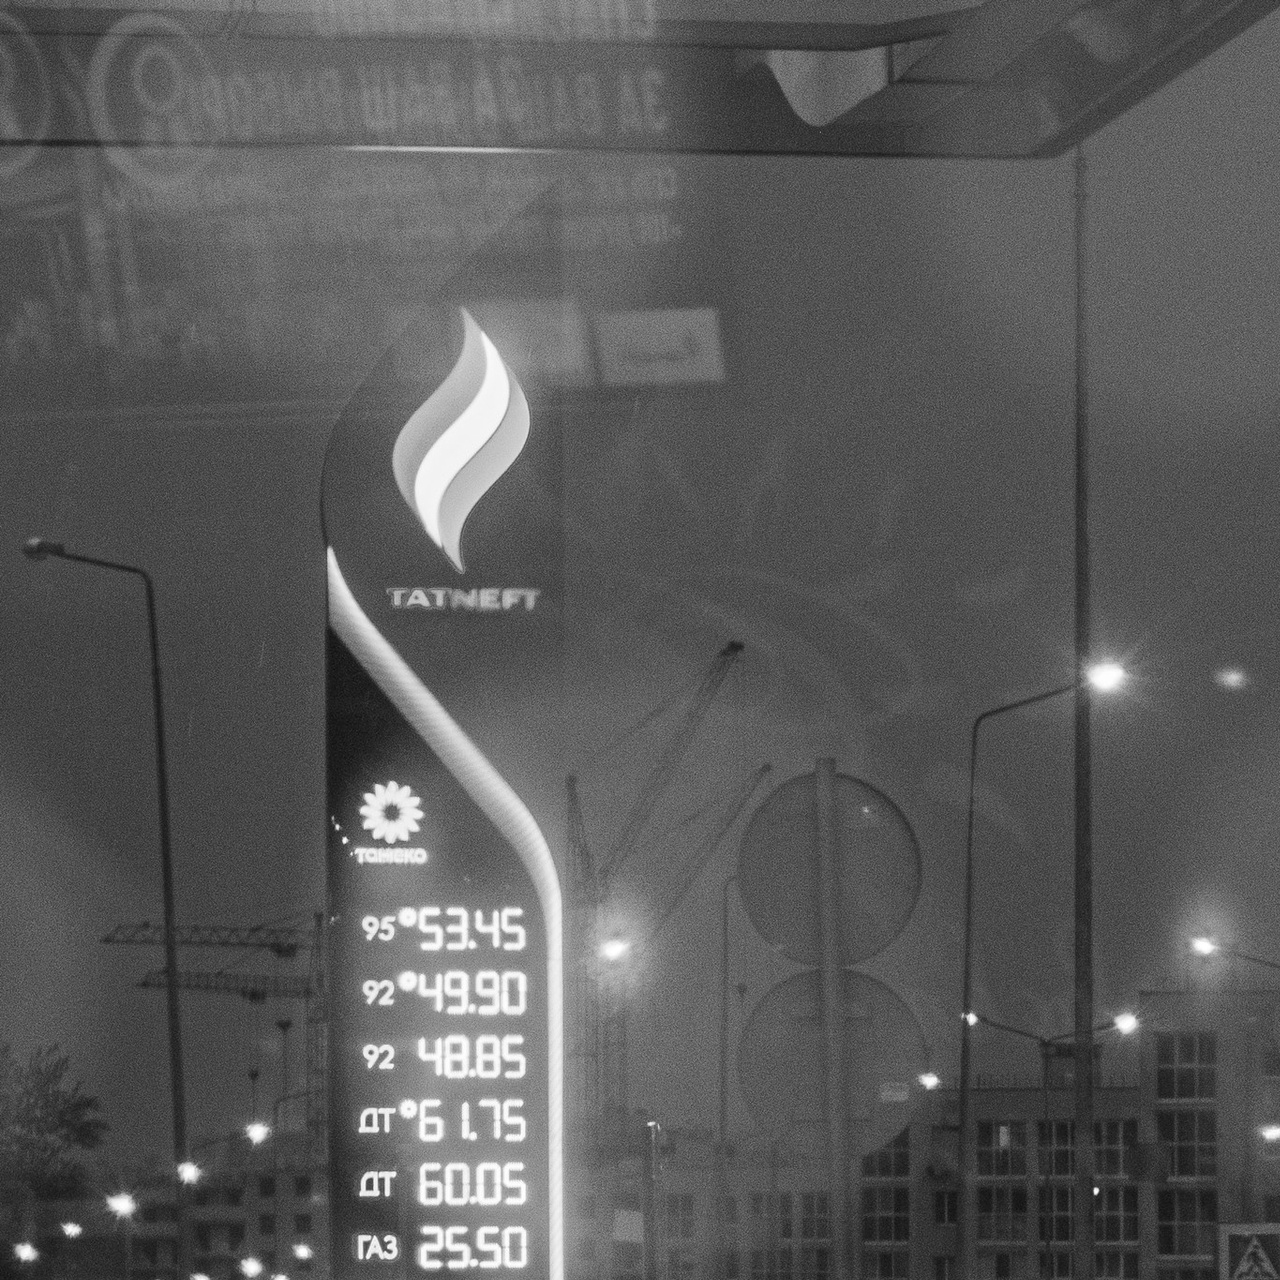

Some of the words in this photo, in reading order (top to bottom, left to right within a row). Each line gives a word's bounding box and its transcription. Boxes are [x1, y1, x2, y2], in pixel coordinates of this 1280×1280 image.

[387, 587, 540, 611] TATNEFT
[362, 917, 395, 941] 95
[418, 908, 527, 949] 53.45
[362, 981, 395, 1006] 92
[418, 972, 527, 1013] 49.90
[362, 1045, 395, 1069] 92
[418, 1035, 527, 1077] 48.85
[358, 1108, 397, 1134] ДТ
[418, 1100, 527, 1141] 61.75
[358, 1171, 397, 1197] ДТ
[418, 1163, 527, 1205] 60.05
[357, 1235, 399, 1261] ГАЗ
[418, 1227, 527, 1268] 25.50
